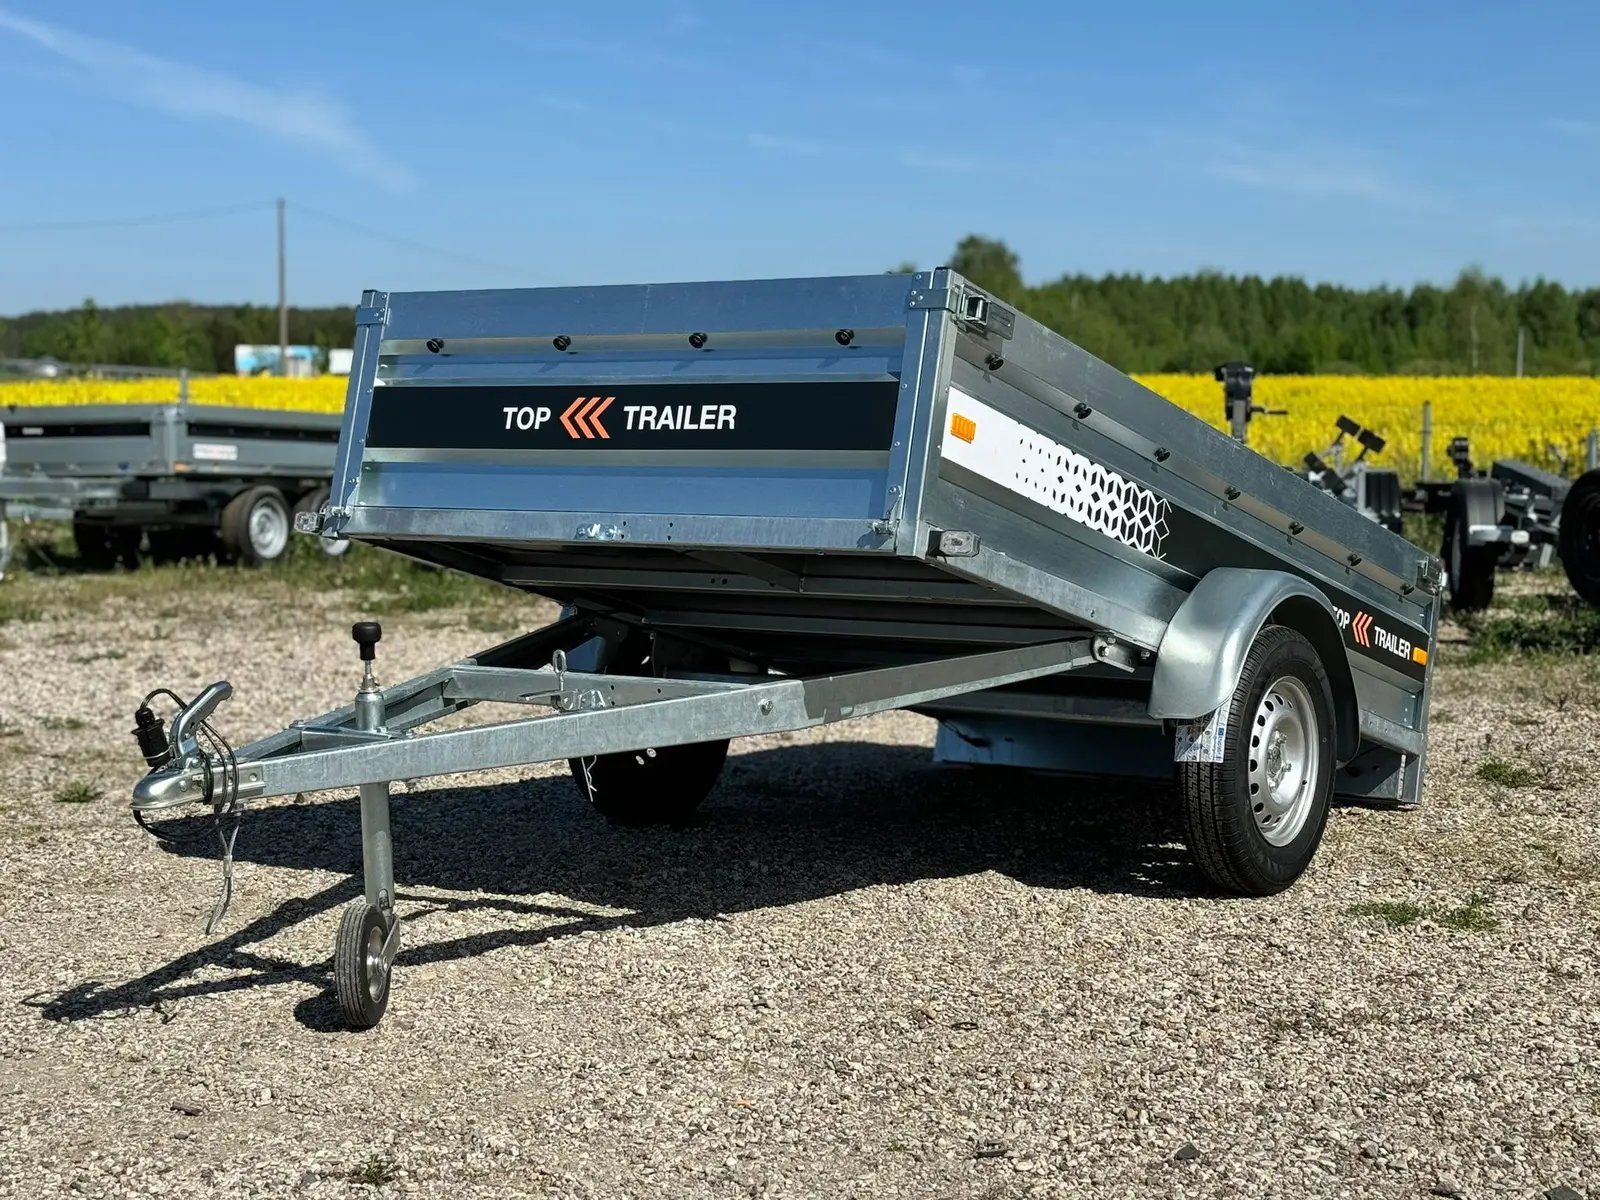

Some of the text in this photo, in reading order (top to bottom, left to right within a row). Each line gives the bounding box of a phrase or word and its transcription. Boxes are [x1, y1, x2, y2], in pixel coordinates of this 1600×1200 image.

[502, 404, 737, 430] TOP TRAILER
[1374, 625, 1411, 661] TRAILER
